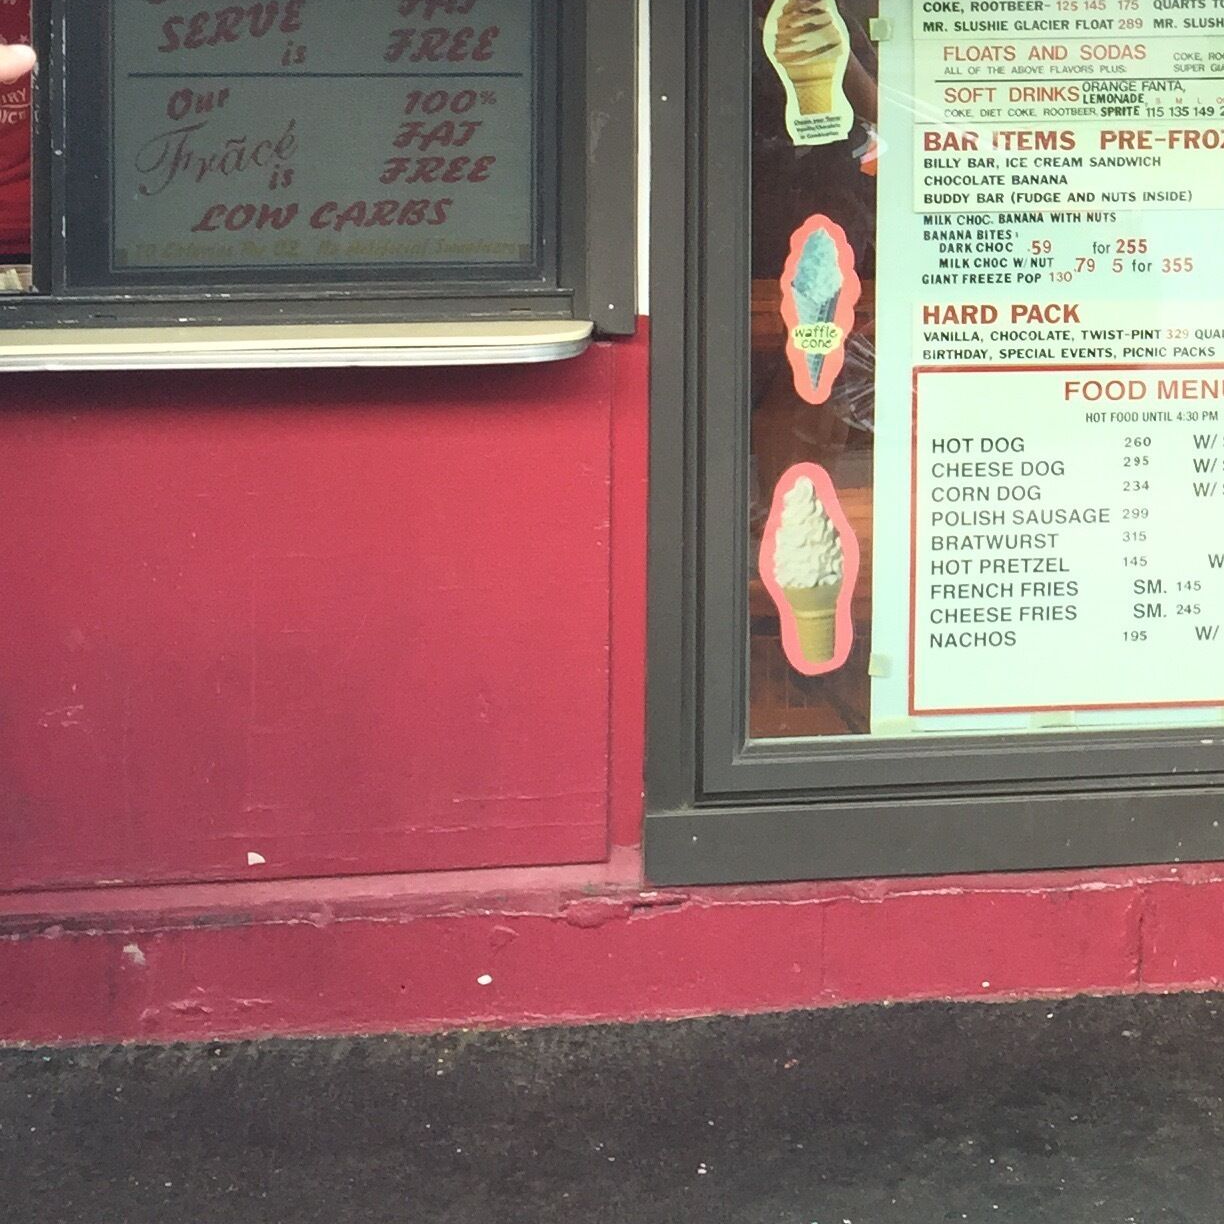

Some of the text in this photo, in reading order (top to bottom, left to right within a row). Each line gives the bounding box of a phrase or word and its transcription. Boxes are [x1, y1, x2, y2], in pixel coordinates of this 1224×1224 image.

[281, 41, 307, 66] is
[383, 26, 499, 63] FREE
[943, 44, 1146, 62] FLOATS AND SODAS
[167, 88, 230, 121] Our
[405, 90, 497, 115] 100%
[944, 85, 1079, 103] SOFT DRINKS
[393, 120, 483, 151] FAT
[924, 131, 979, 152] BAR
[992, 130, 1075, 151] ITEMS
[379, 155, 496, 184] FREE
[924, 155, 1161, 170] BILLY BAR, ICE CREAM SANDWICH
[269, 164, 295, 190] is
[924, 175, 1068, 186] CHOCOLATE BANANA
[191, 198, 453, 232] LOW CARBS
[923, 303, 1080, 325] HARD PACK
[795, 326, 838, 338] waffle
[802, 339, 832, 348] cone
[1064, 380, 1147, 401] FOOD
[1086, 411, 1218, 423] HOT FOOD UNTIL 4:30 PM
[932, 438, 974, 454] HOT
[981, 437, 1025, 454] DOG
[1124, 437, 1151, 448] 260
[1193, 433, 1217, 450] W/
[932, 462, 1013, 478] CHEESE
[1021, 461, 1065, 477] DOG
[1123, 456, 1150, 468] 295
[1193, 457, 1217, 473] W/
[932, 486, 991, 502] CORN
[998, 485, 1041, 501] DOG
[1122, 480, 1149, 492] 234
[1193, 481, 1217, 497] W/
[931, 508, 1149, 526] POLISH SAUSAGE 299
[931, 531, 1147, 551] BRATWURST 315
[931, 559, 973, 575] HOT
[979, 557, 1070, 575] PRETZEL
[1122, 556, 1148, 567] 145
[930, 583, 1013, 600] FRENCH
[1020, 581, 1078, 598] FRIES
[1133, 580, 1167, 595] SM.
[1176, 580, 1201, 592] 145
[930, 607, 1012, 624] CHEESE
[1019, 605, 1077, 622] FRIES
[1133, 604, 1167, 619] SM.
[1176, 603, 1201, 615] 245
[930, 631, 1016, 648] NACHOS
[1122, 631, 1147, 642] 195
[1195, 625, 1220, 641] W/
